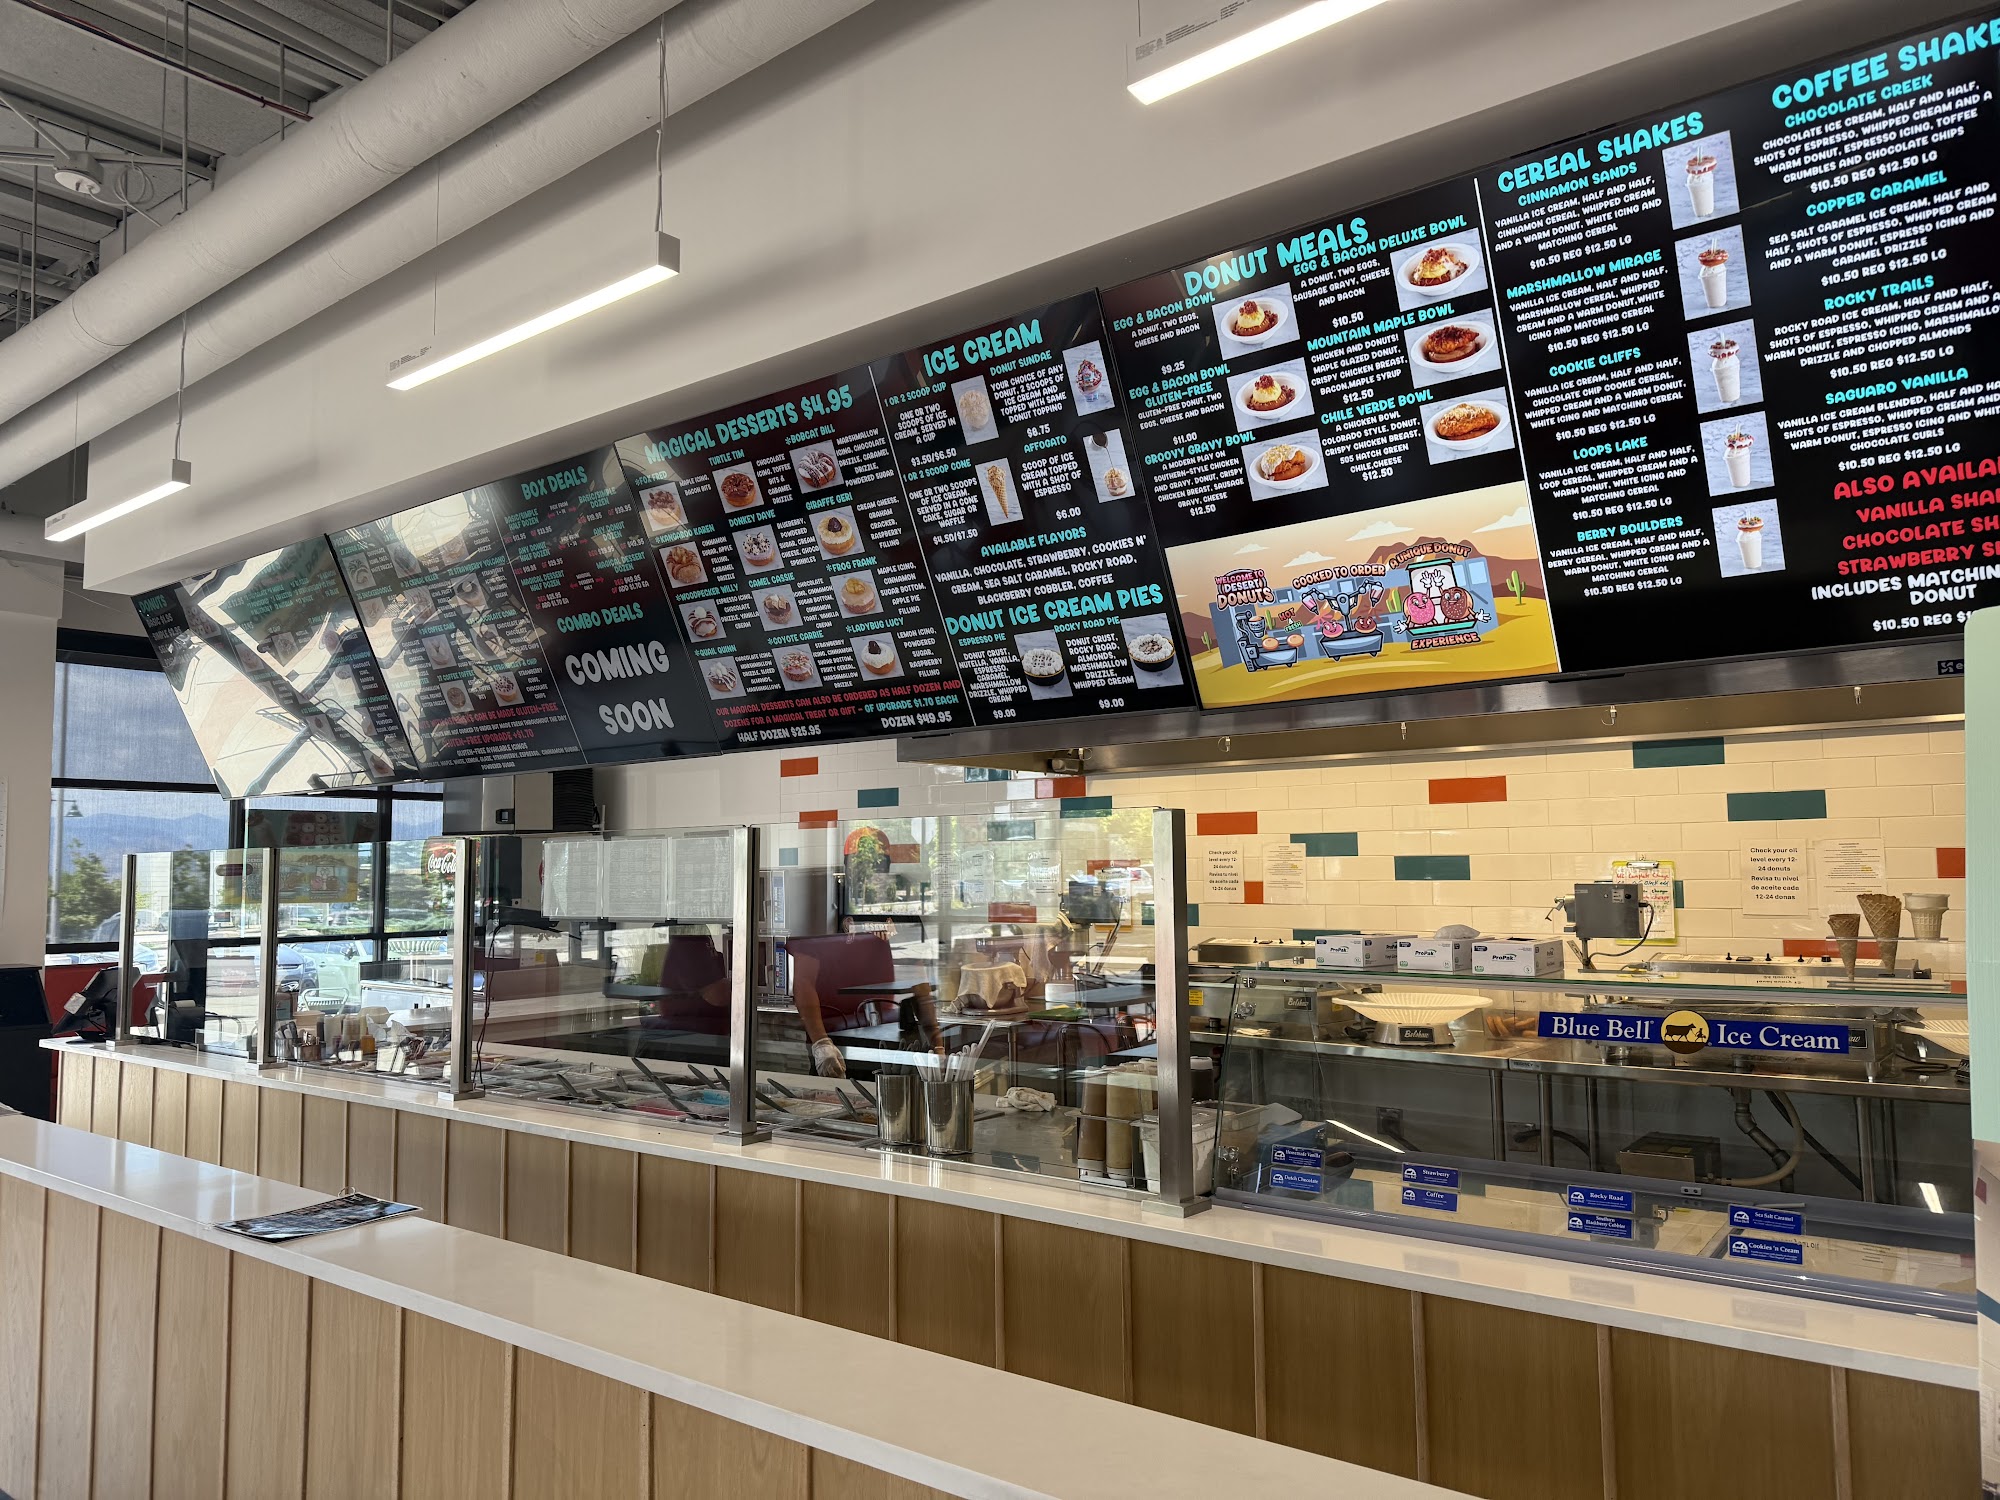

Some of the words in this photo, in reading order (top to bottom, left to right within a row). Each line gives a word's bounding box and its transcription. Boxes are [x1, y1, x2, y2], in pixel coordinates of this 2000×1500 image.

[1772, 52, 1889, 109] COFFEE
[1785, 90, 1876, 128] CHOCOLATE
[1880, 73, 1933, 99] CREEK
[1498, 148, 1591, 192] CEREAL
[1597, 111, 1703, 162] SHAKES
[1518, 176, 1589, 206] CINNAMON
[1592, 161, 1637, 184] SANDS
[1810, 174, 1848, 193] $10.50
[1851, 167, 1875, 182] REG
[1878, 155, 1919, 175] $12.50
[1921, 150, 1937, 163] LG
[1806, 191, 1866, 216] COPPER
[1870, 170, 1947, 200] CARAMEL
[1183, 246, 1267, 296] DONUT
[1276, 217, 1368, 267] MEALS
[1293, 259, 1317, 276] EGG
[1320, 255, 1330, 268] &
[1332, 241, 1376, 264] BACON
[1379, 225, 1427, 250] DELUXE
[1429, 214, 1467, 235] BOWL
[1506, 263, 1605, 299] MARSHMALLOW
[1609, 249, 1661, 272] MIRAGE
[1824, 288, 1877, 310] ROCKY
[1881, 275, 1934, 297] TRAILS
[1113, 316, 1133, 331] EGG
[1136, 313, 1144, 324] &
[1146, 300, 1183, 321] BACON
[1184, 290, 1215, 309] BOWL
[1332, 311, 1364, 328] $10.50
[1307, 324, 1371, 351] MOUNTAIN
[1373, 312, 1415, 333] MAPLE
[1418, 303, 1455, 322] BOWL
[923, 345, 959, 377] ICE
[963, 319, 1043, 364] CREAM
[1549, 357, 1596, 376] COOKIE
[1598, 347, 1641, 366] CLIFFS
[990, 360, 1016, 376] DONUT
[1018, 349, 1052, 367] SUNDAE
[1161, 360, 1185, 375] $9.25
[1145, 381, 1213, 408] GLUTEN-FREE
[1825, 381, 1897, 404] SAGUARO
[1901, 367, 1968, 390] VANILLA
[1321, 407, 1354, 424] CHILE
[1356, 397, 1395, 416] VERDE
[1398, 389, 1433, 406] BOWL
[644, 428, 717, 466] MAGICAL
[715, 402, 798, 444] DESSERTS
[800, 384, 852, 420] $4.95
[1026, 423, 1050, 438] $8.75
[708, 452, 732, 466] TURTLE
[731, 449, 745, 459] TIM
[1024, 435, 1067, 453] AFFOGATO
[1144, 447, 1184, 465] GROOVY
[1188, 438, 1222, 455] GRAVY
[1225, 430, 1256, 446] BOWL
[1573, 443, 1612, 460] LOOPS
[1615, 436, 1648, 452] LAKE
[521, 478, 547, 500] BOX
[547, 466, 588, 492] DEALS
[1834, 475, 1894, 500] ALSO
[1903, 456, 2000, 489] AVAILA
[728, 513, 755, 527] DONKEY
[756, 509, 776, 521] DAVE
[1056, 506, 1081, 520] $6.00
[1856, 497, 1944, 522] VANILLA
[1950, 488, 2000, 509] SHA
[981, 536, 1036, 557] AVAILABLE
[1037, 526, 1086, 546] FLAVORS
[1577, 526, 1616, 542] BERRY
[1619, 515, 1683, 535] BOULDERS
[1842, 519, 1965, 550] CHOCOLATE
[1971, 515, 2000, 532] SH
[1390, 558, 1398, 569] A
[1397, 544, 1433, 564] UNIQUE
[1434, 543, 1472, 558] DONUT
[1837, 544, 1974, 575] STRAWBERRY
[748, 577, 771, 588] CAMEL
[771, 572, 795, 583] CASSIE
[1216, 574, 1254, 585] WELCOME
[1254, 570, 1265, 580] TO
[1224, 580, 1261, 593] DESERT
[1293, 570, 1334, 589] COOKED
[1334, 566, 1349, 578] TO
[1350, 565, 1386, 577] ORDER
[1811, 576, 1902, 600] INCLUDES
[1907, 564, 2000, 589] MATCHIN
[1217, 588, 1274, 610] DONUTS
[1909, 583, 1977, 605] DONUT
[556, 611, 601, 633] COMBO
[601, 602, 643, 625] DEALS
[946, 610, 1004, 636] DONUT
[1008, 603, 1040, 625] ICE
[1044, 591, 1114, 620] CREAM
[1116, 583, 1163, 609] PIES
[1278, 608, 1296, 621] HOT
[1054, 621, 1082, 635] ROCKY
[1082, 618, 1106, 630] ROAD
[1106, 616, 1121, 628] PIE
[1285, 622, 1303, 633] FRESH
[1412, 633, 1480, 650] EXPERIENCE
[565, 640, 669, 685] COMING
[599, 698, 674, 735] SOON
[1098, 697, 1124, 709] $9.00
[881, 714, 915, 728] DOZEN
[916, 710, 952, 725] $49.95
[1552, 1017, 1599, 1038] Blue
[1607, 1020, 1651, 1041] Bell
[1717, 1023, 1751, 1045] Ice
[1759, 1026, 1840, 1049] Cream
[1284, 1175, 1298, 1183] Dutch
[1298, 1177, 1319, 1185] Chocolate
[1422, 1170, 1451, 1179] Strawberry
[1426, 1191, 1445, 1199] Coffee
[1590, 1192, 1607, 1200] Rocky
[1748, 1242, 1772, 1252] Cookies
[1780, 1246, 1800, 1255] Cream
